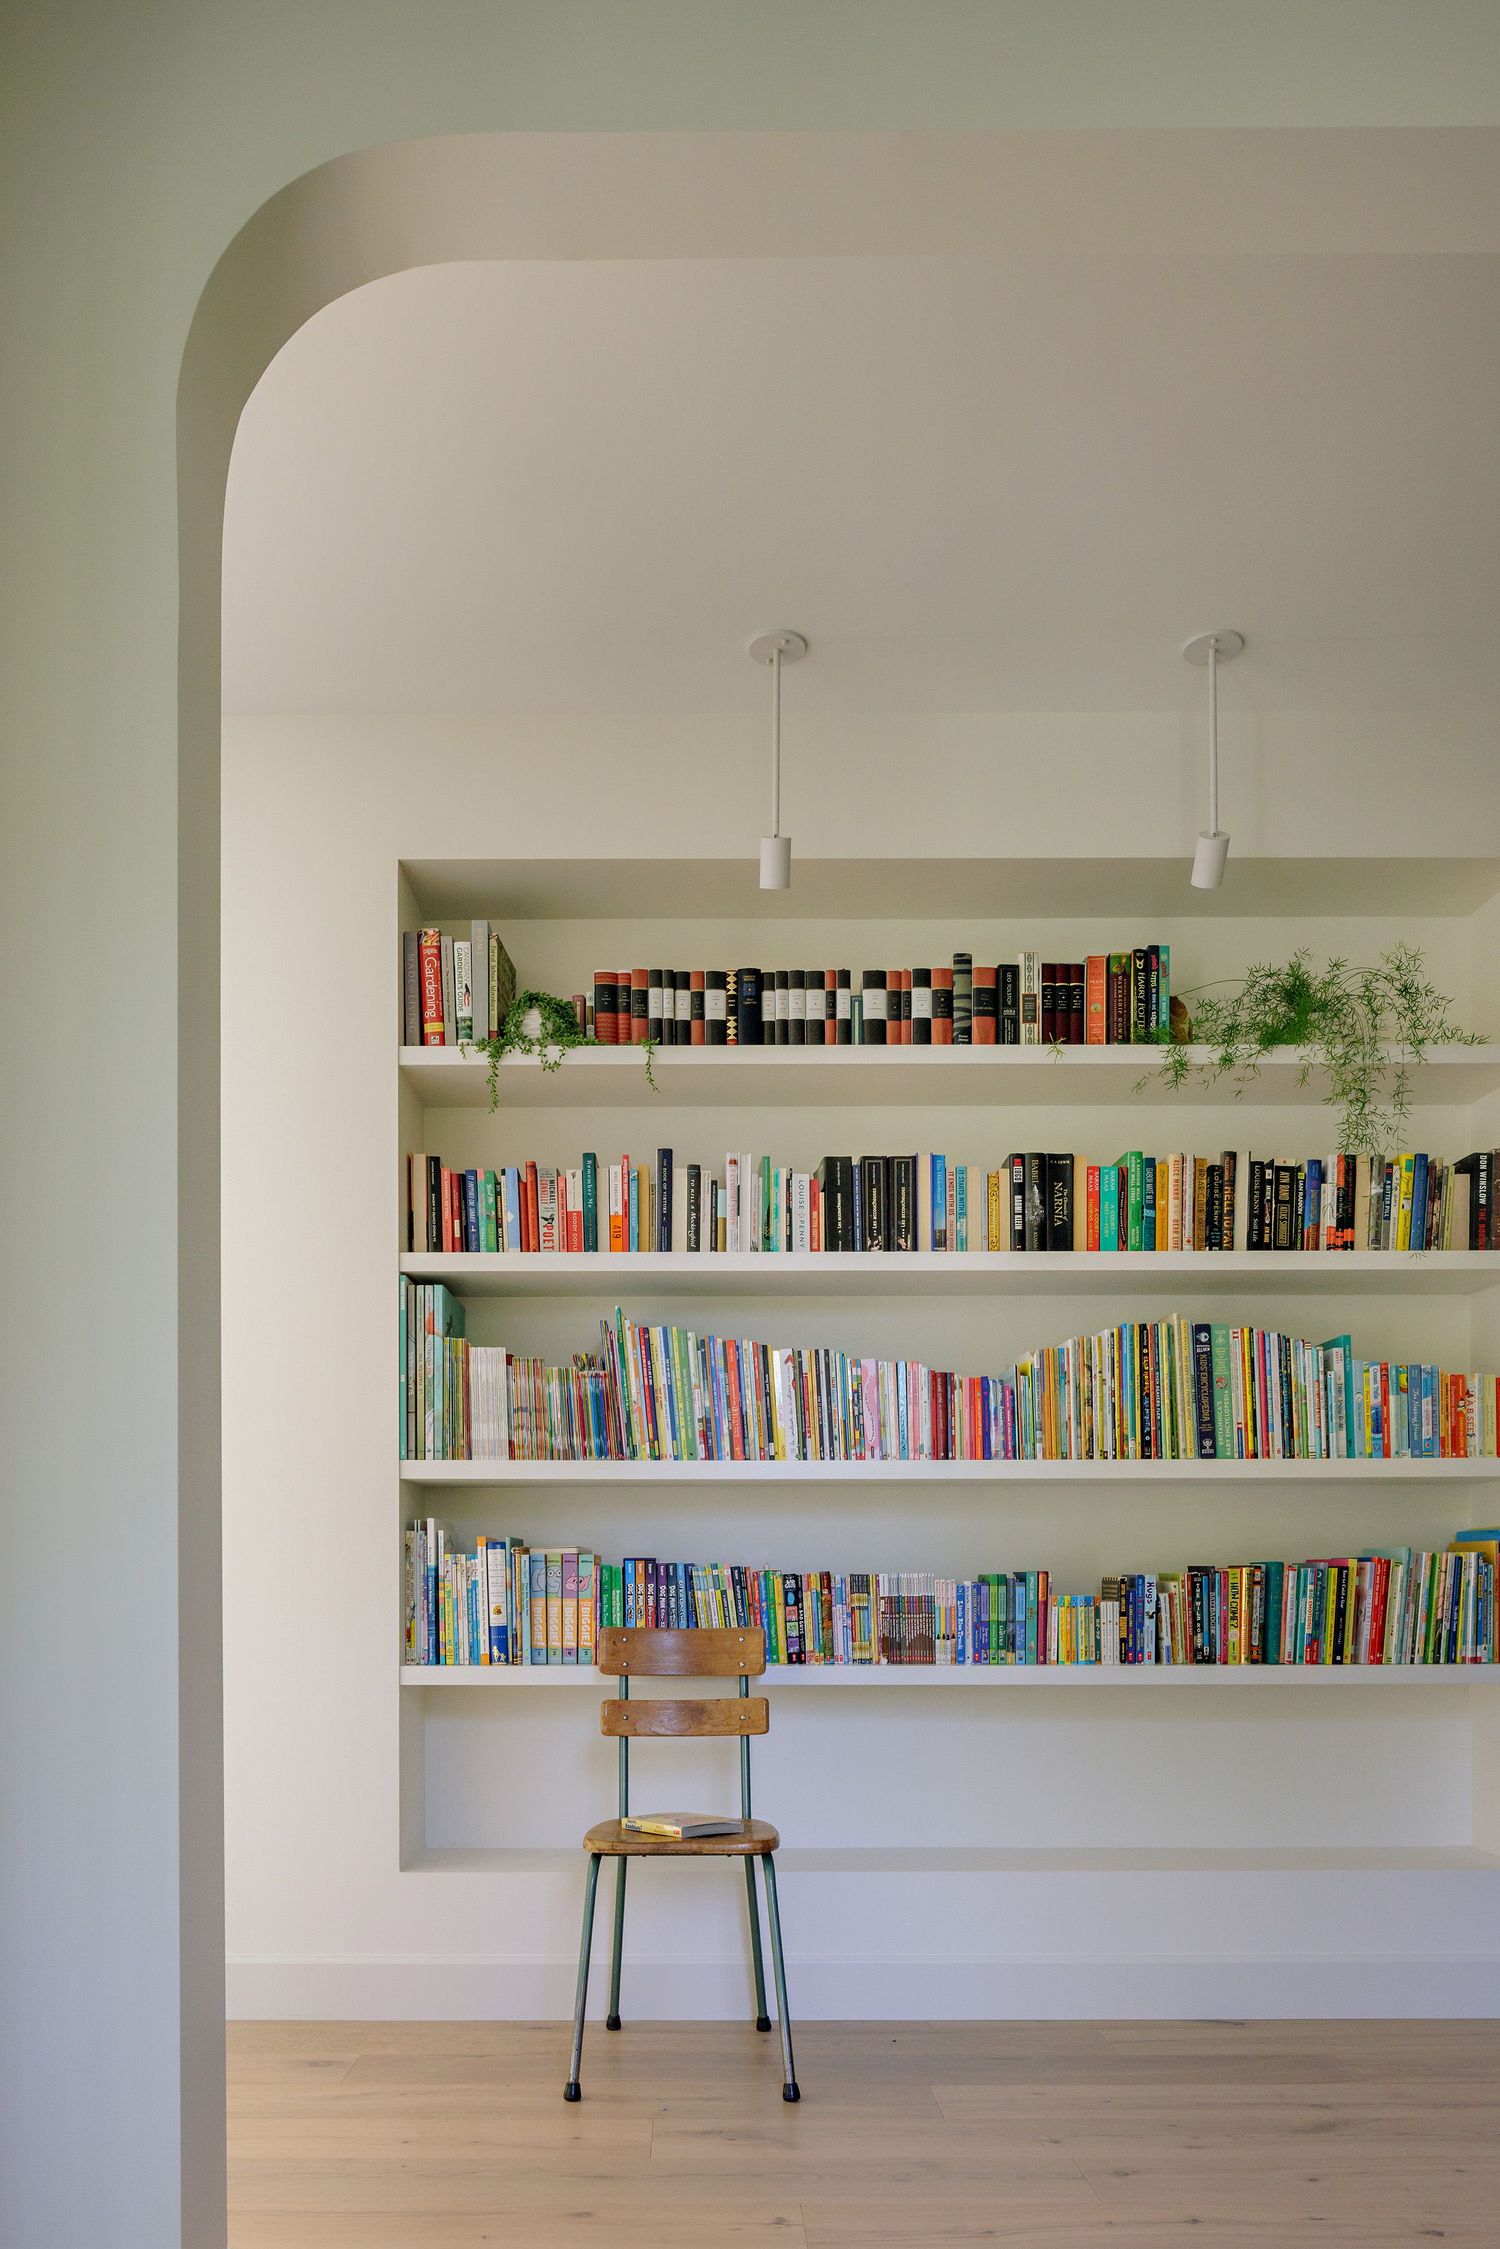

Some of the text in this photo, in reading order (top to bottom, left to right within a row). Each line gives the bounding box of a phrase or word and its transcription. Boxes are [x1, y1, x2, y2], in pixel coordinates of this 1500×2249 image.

[424, 957, 438, 1018] Gardening
[1138, 972, 1146, 1001] HARRY
[540, 1179, 548, 1204] CONNELLY
[1279, 1172, 1289, 1201] AYN RAND
[1479, 1155, 1487, 1204] DON WINSLOW
[1014, 1195, 1022, 1229] NAOMI KLEIN
[1054, 1182, 1063, 1226] NARNIA
[1224, 1186, 1232, 1248] HELL TO PAY
[1279, 1206, 1287, 1219] ATLAS
[542, 1224, 554, 1250] POET
[612, 1225, 621, 1239] 419
[1200, 1372, 1209, 1421] ENCYCLOPEDIA
[1146, 1582, 1155, 1604] Hugs
[1230, 1582, 1238, 1628] HOW COME?
[533, 1606, 543, 1646] BIGGIE!
[549, 1606, 560, 1646] BIGGIE!
[564, 1606, 575, 1646] BIGGIE!
[580, 1606, 592, 1646] BIGGIE!
